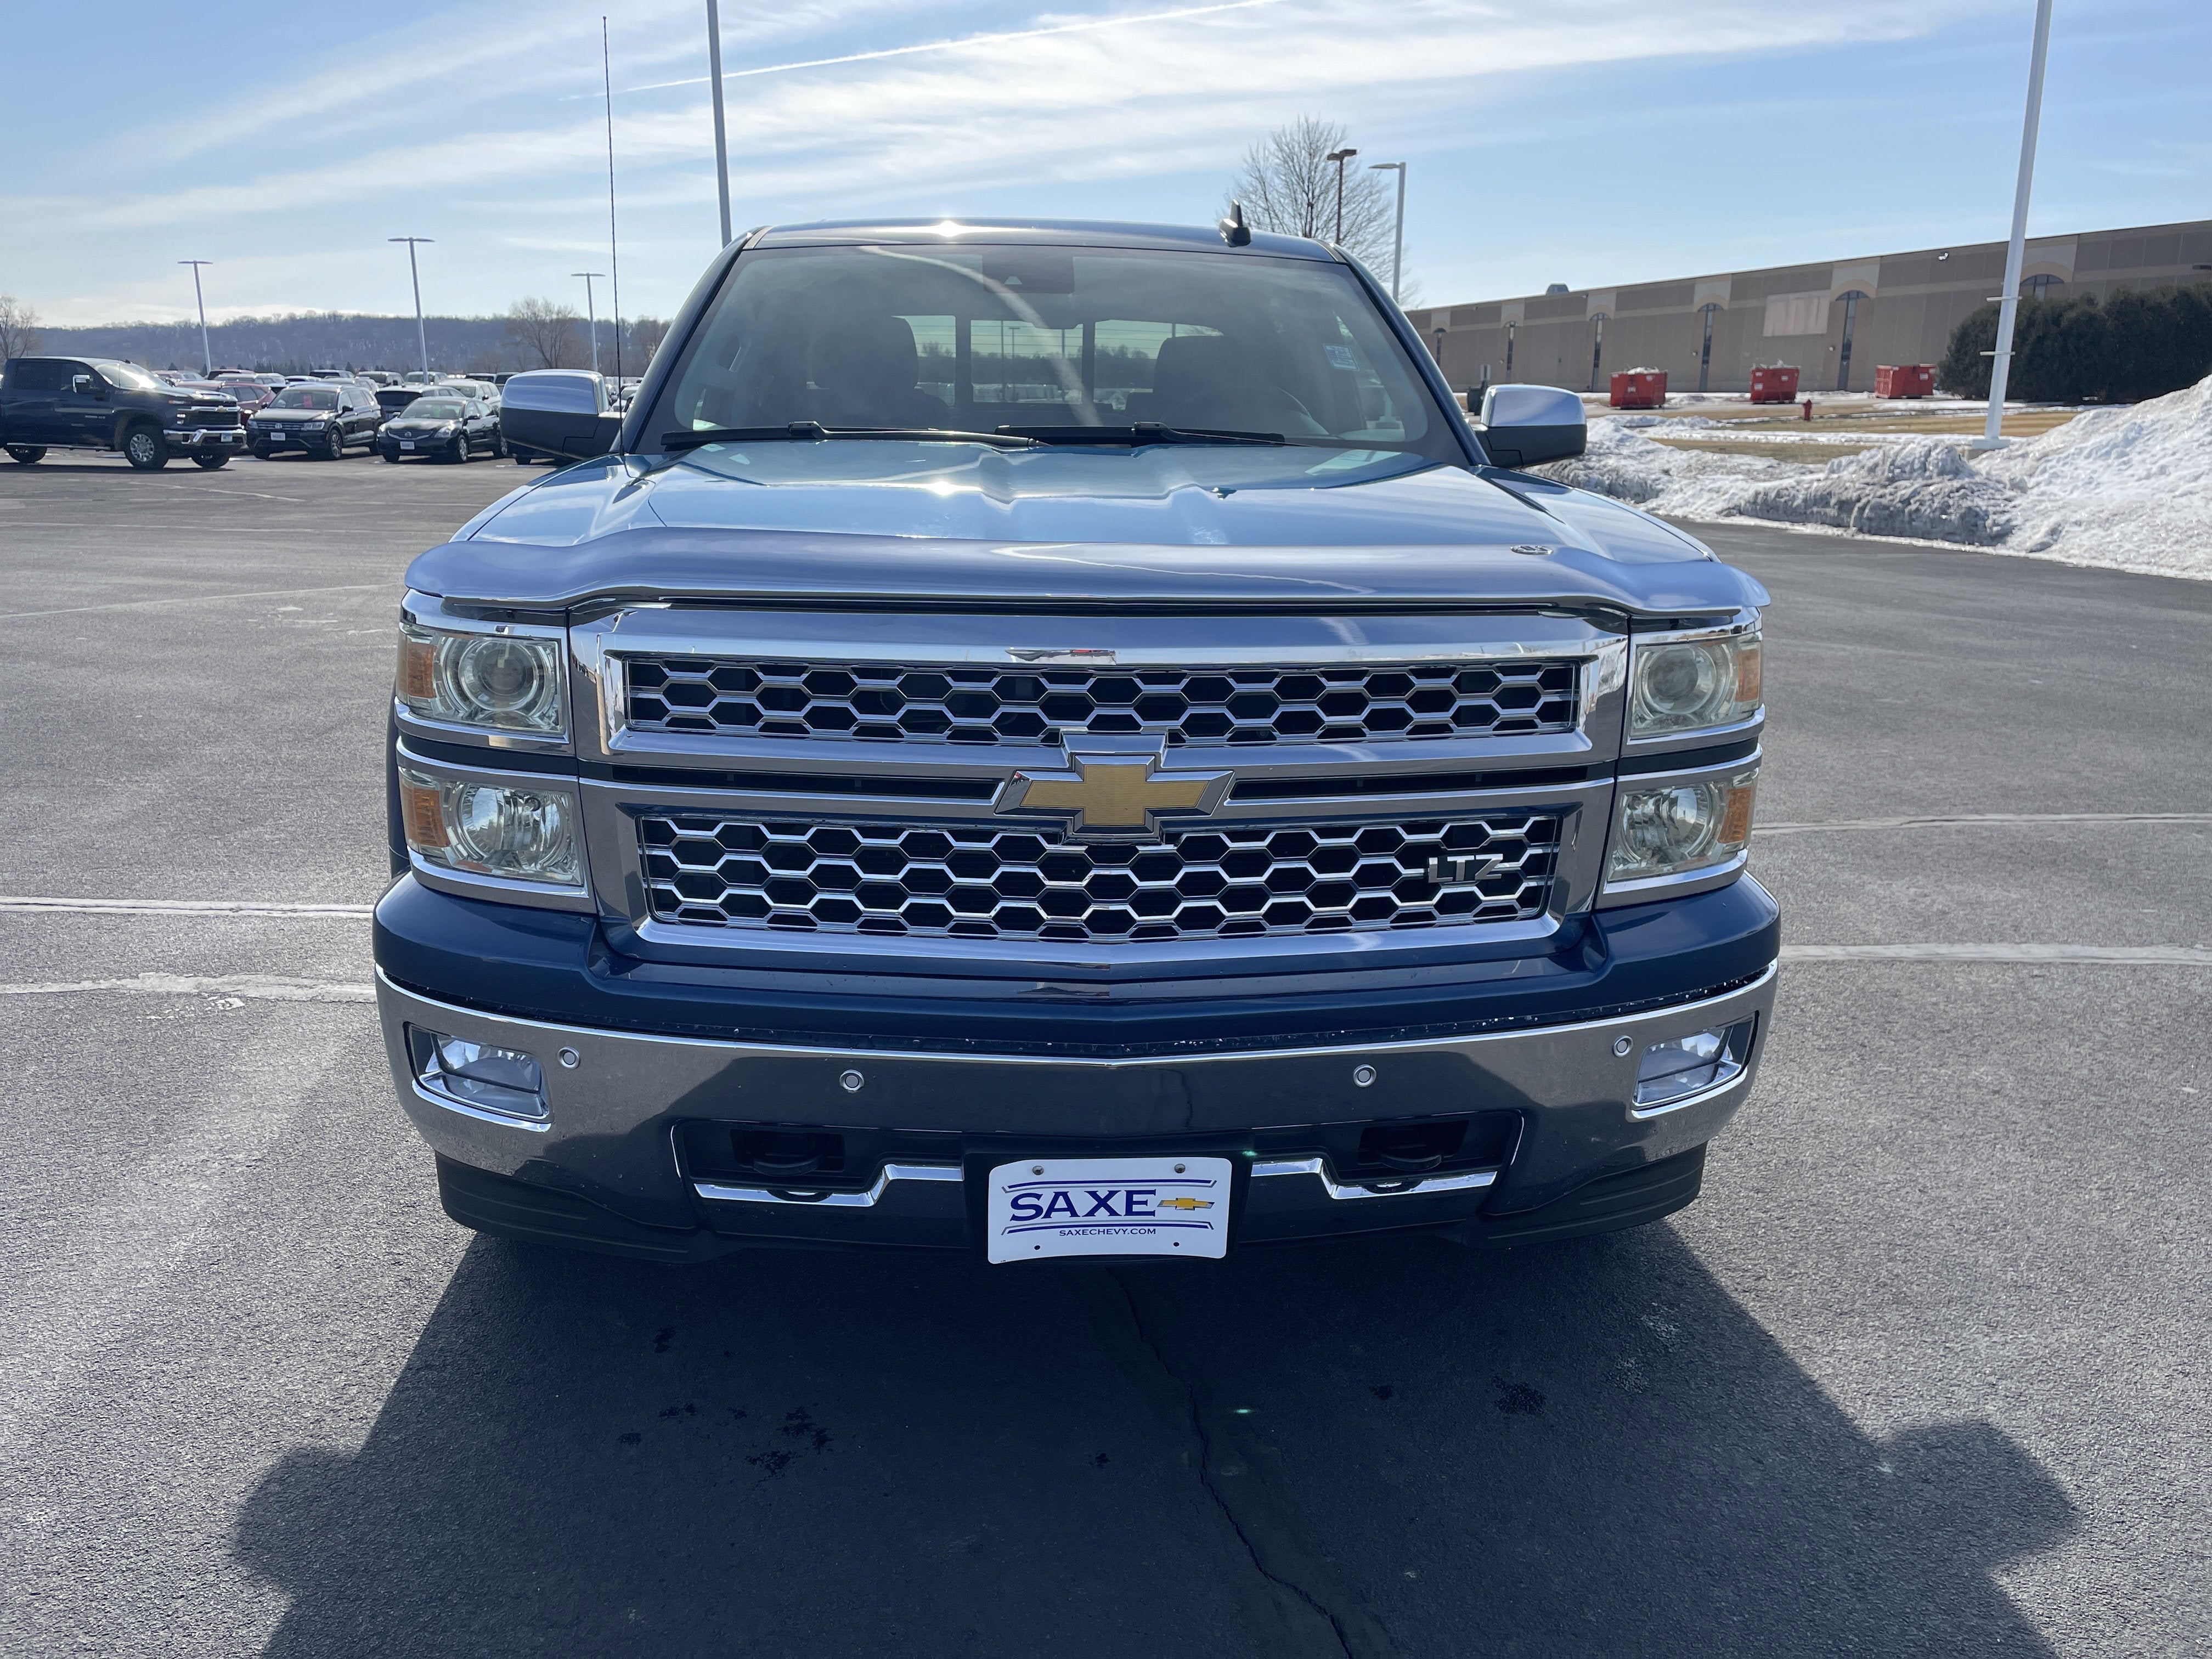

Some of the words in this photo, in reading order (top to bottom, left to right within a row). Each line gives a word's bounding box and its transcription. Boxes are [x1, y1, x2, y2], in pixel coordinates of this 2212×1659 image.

[1428, 853, 1503, 884] LTZ
[1009, 1189, 1156, 1222] SAXE
[1059, 1228, 1156, 1237] SAXECHEVY.COM
